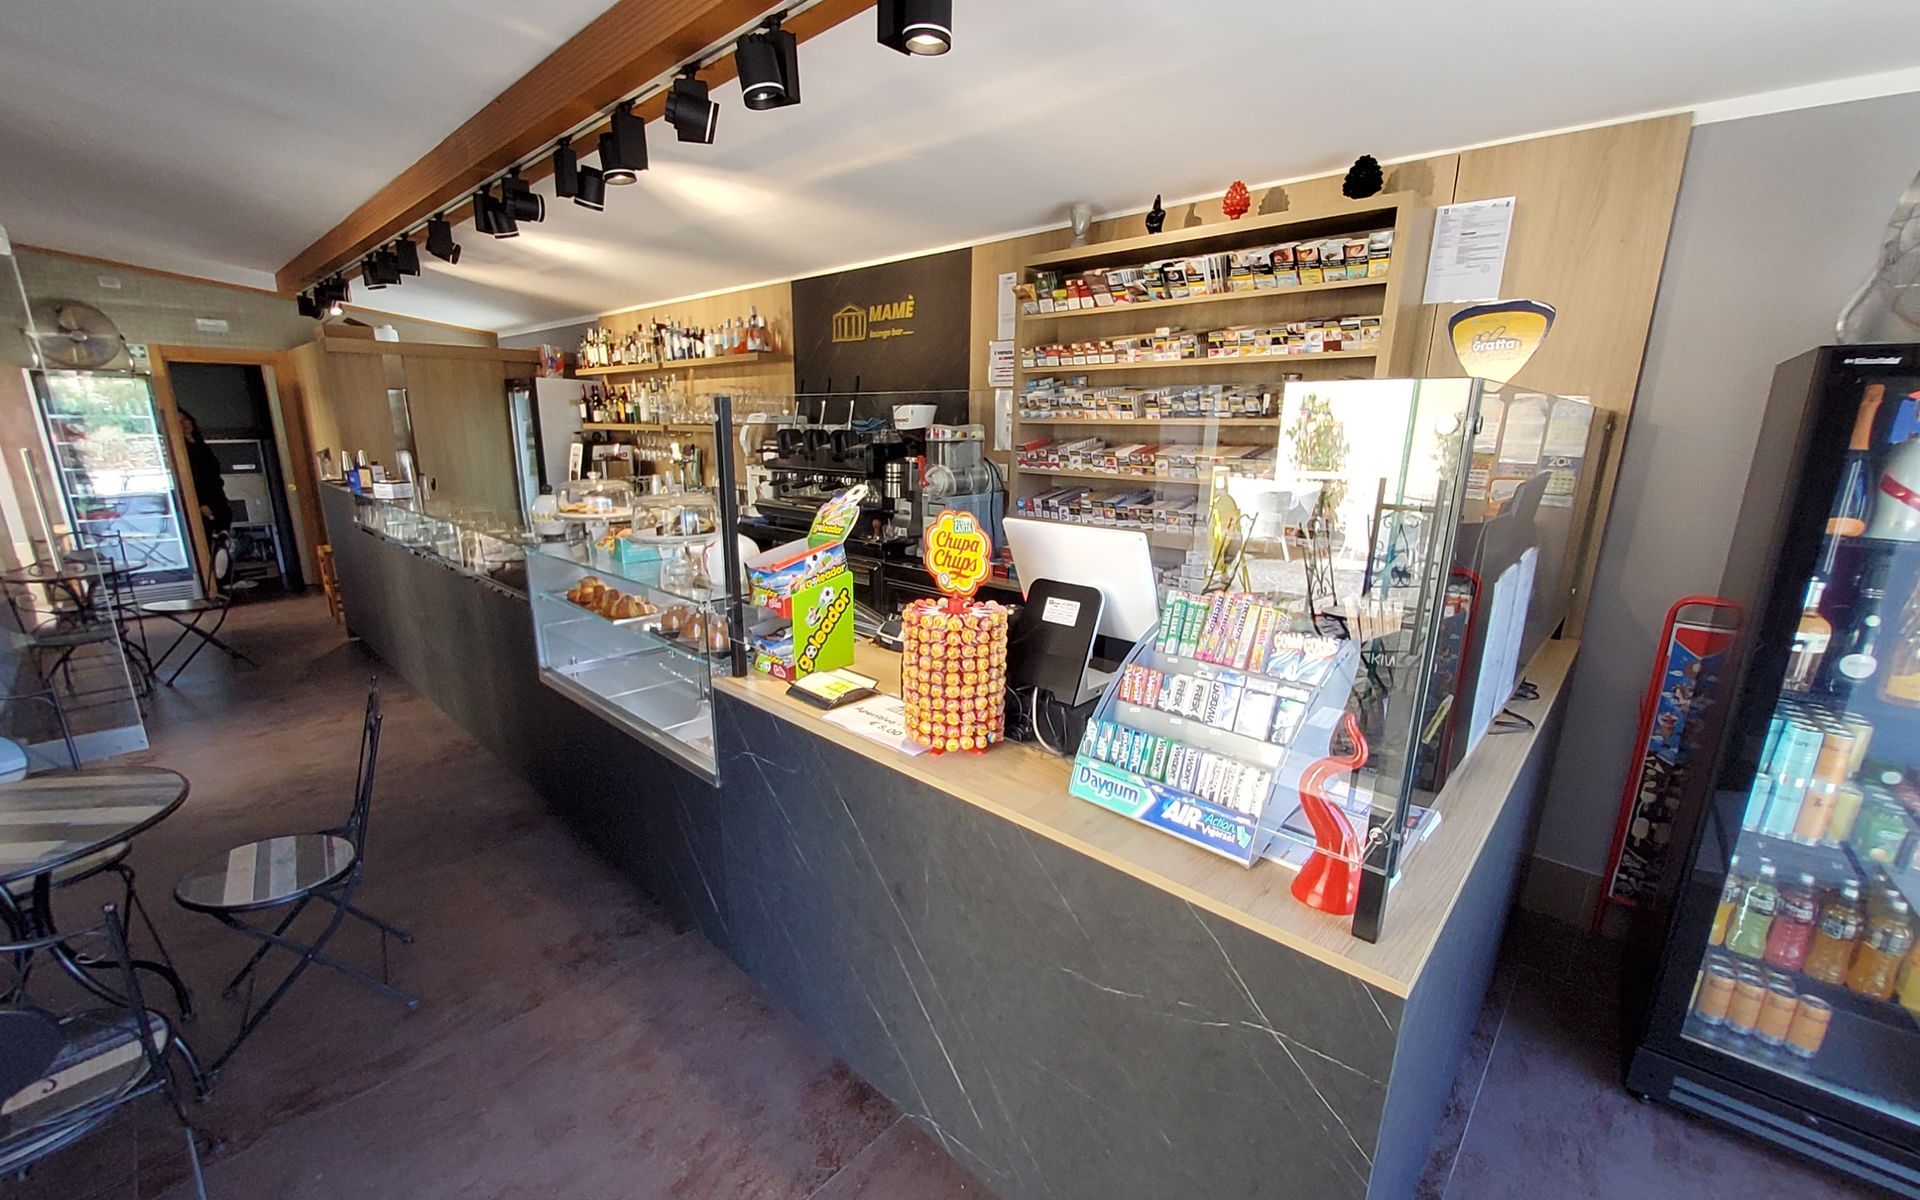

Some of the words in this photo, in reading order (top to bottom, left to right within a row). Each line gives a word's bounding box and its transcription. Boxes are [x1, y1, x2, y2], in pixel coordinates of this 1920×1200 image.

[868, 294, 915, 322] MAMÈ
[891, 327, 903, 337] bar
[1472, 338, 1515, 353] Gratta
[936, 530, 980, 555] Chupa
[934, 548, 978, 573] Chups
[1207, 595, 1225, 635] mentos
[1173, 680, 1186, 707] FRISK
[1190, 684, 1204, 713] FRISK
[1205, 681, 1220, 724] VIVIDENT
[1079, 766, 1138, 803] Daygum
[1161, 800, 1202, 830] AIR
[1205, 813, 1237, 834] Action
[1200, 823, 1236, 844] Vigorsol
